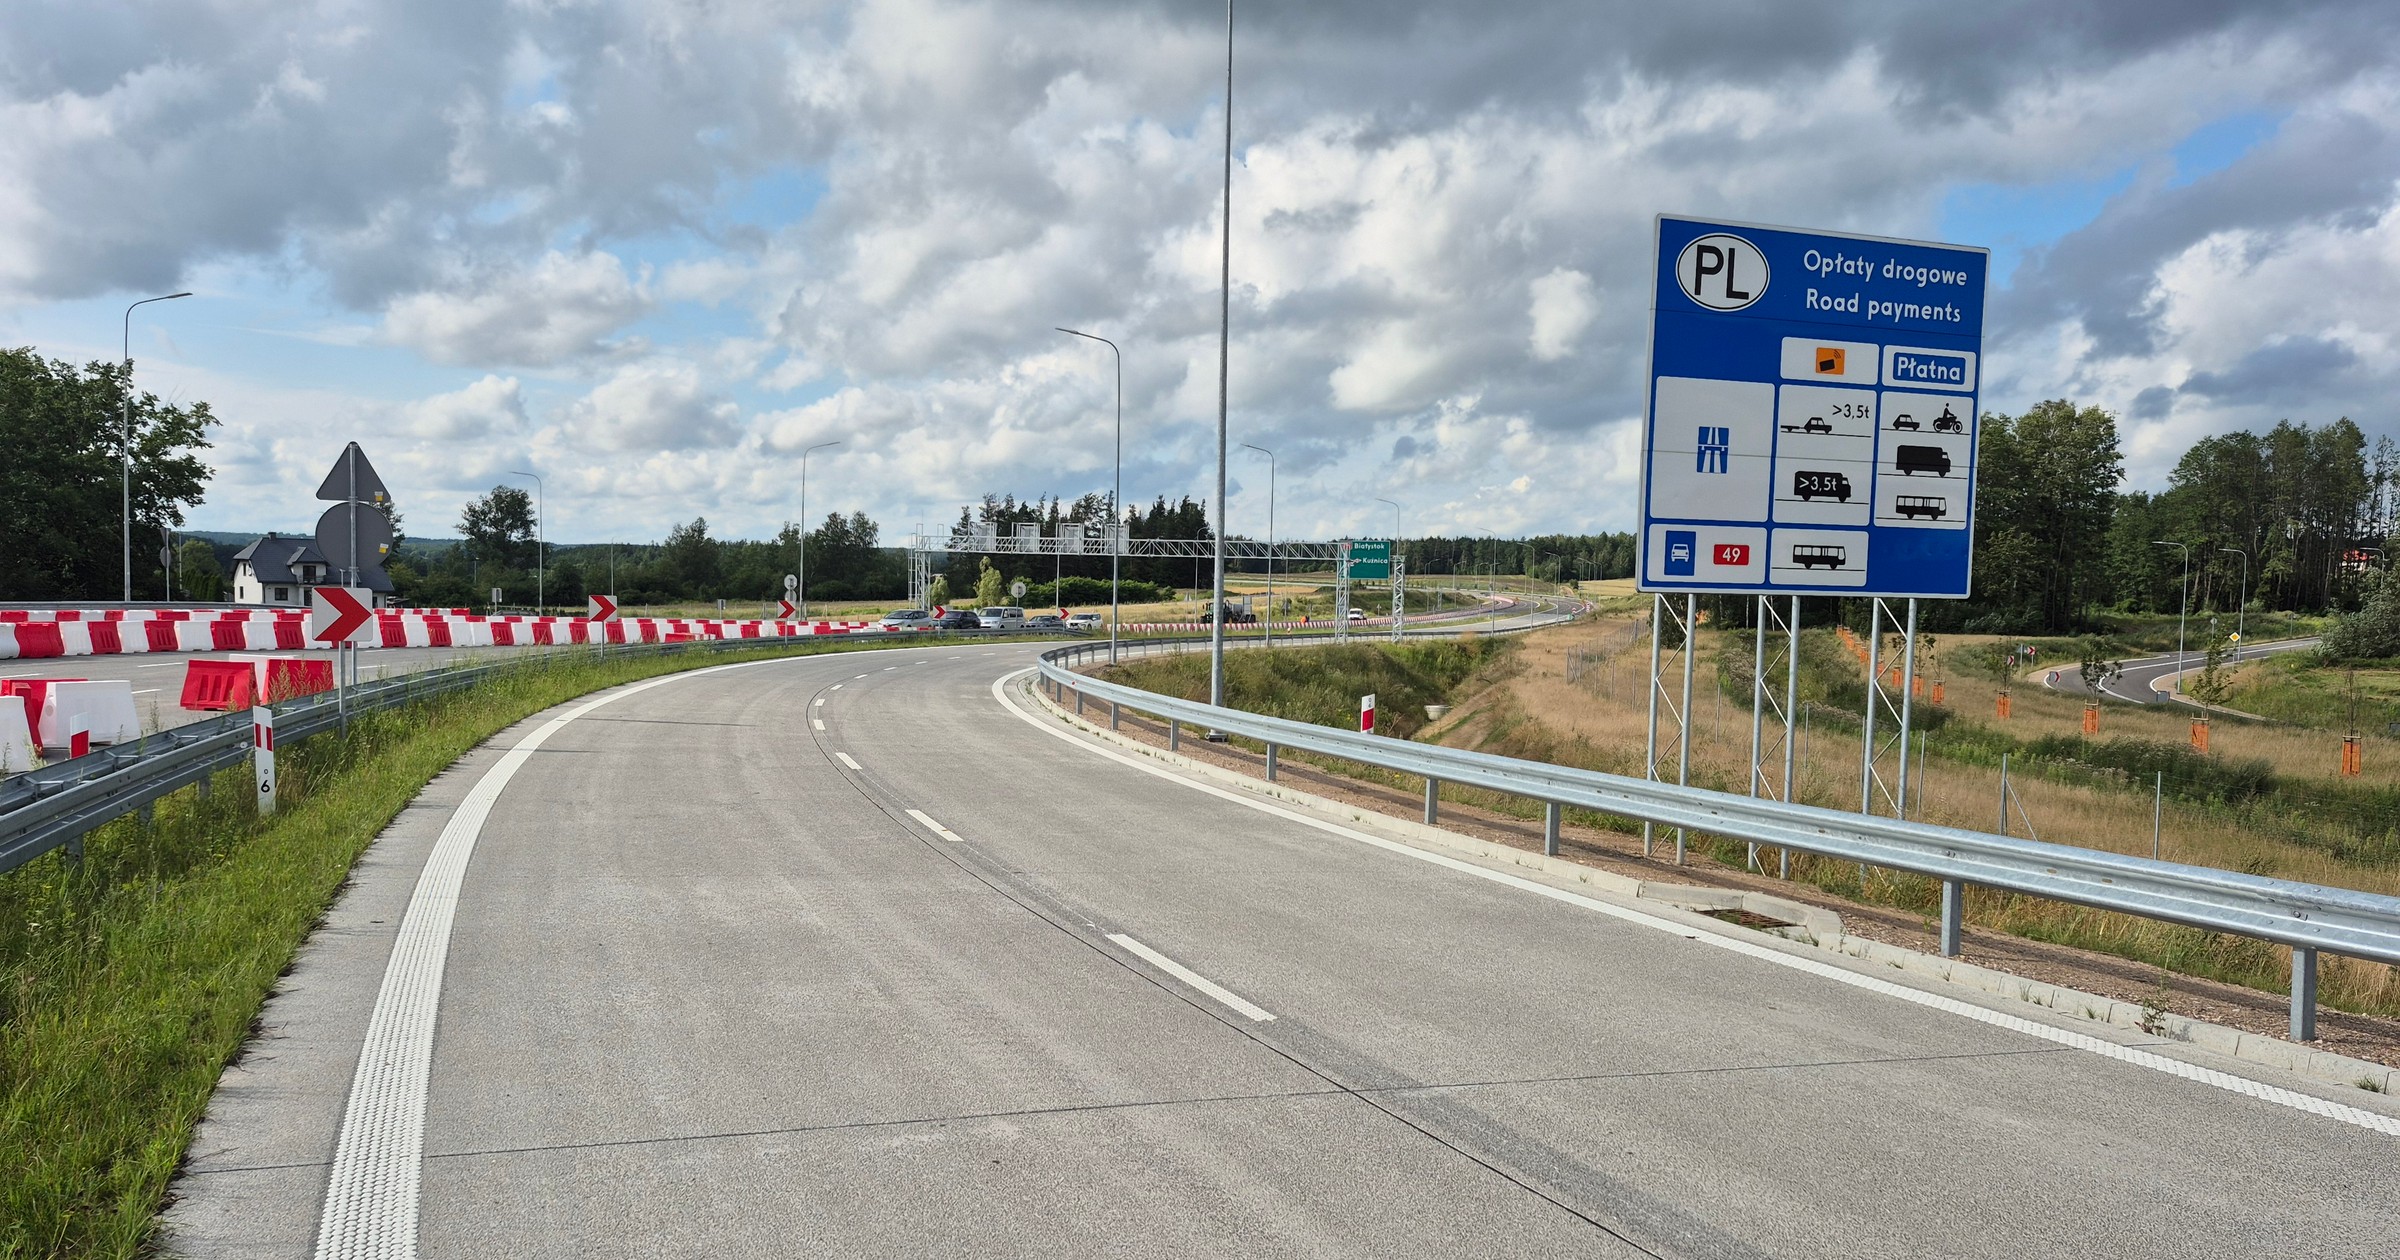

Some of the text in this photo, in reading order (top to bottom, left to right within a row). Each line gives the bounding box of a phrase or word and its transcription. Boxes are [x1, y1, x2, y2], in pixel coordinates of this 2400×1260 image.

[1694, 244, 1749, 300] PL
[1803, 249, 1968, 288] Opłaty drogowe
[1806, 288, 1961, 323] Road payments
[1897, 356, 1961, 382] Płatna
[1832, 404, 1870, 420] >3,5t
[1799, 476, 1837, 492] >3,5t
[1722, 547, 1741, 562] 49
[261, 780, 270, 792] 6
